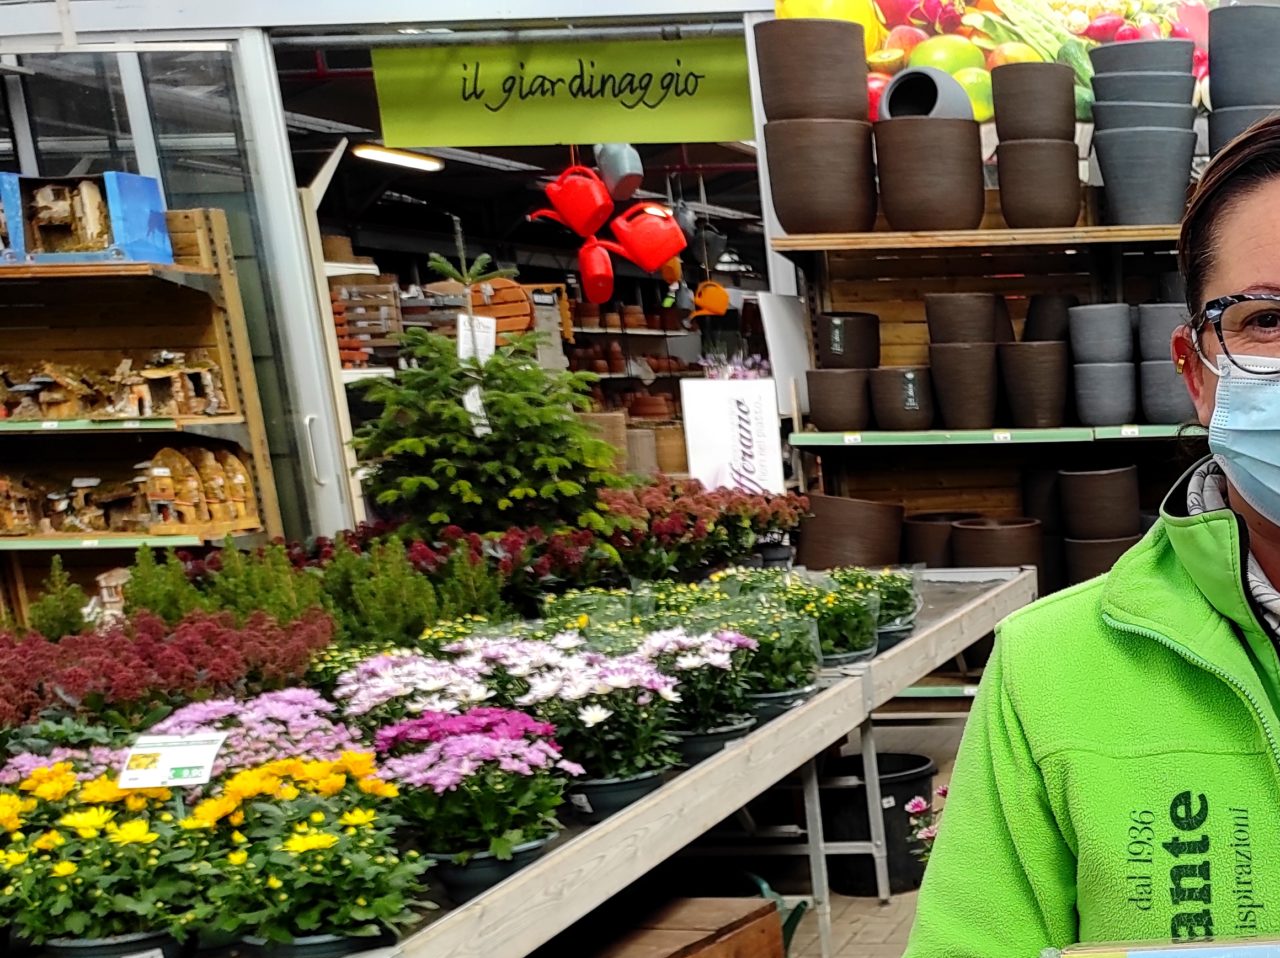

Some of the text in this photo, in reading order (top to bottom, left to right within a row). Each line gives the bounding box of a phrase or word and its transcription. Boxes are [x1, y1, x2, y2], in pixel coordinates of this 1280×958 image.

[462, 58, 706, 112] il giardinaggio
[1127, 810, 1156, 911] dal 1936
